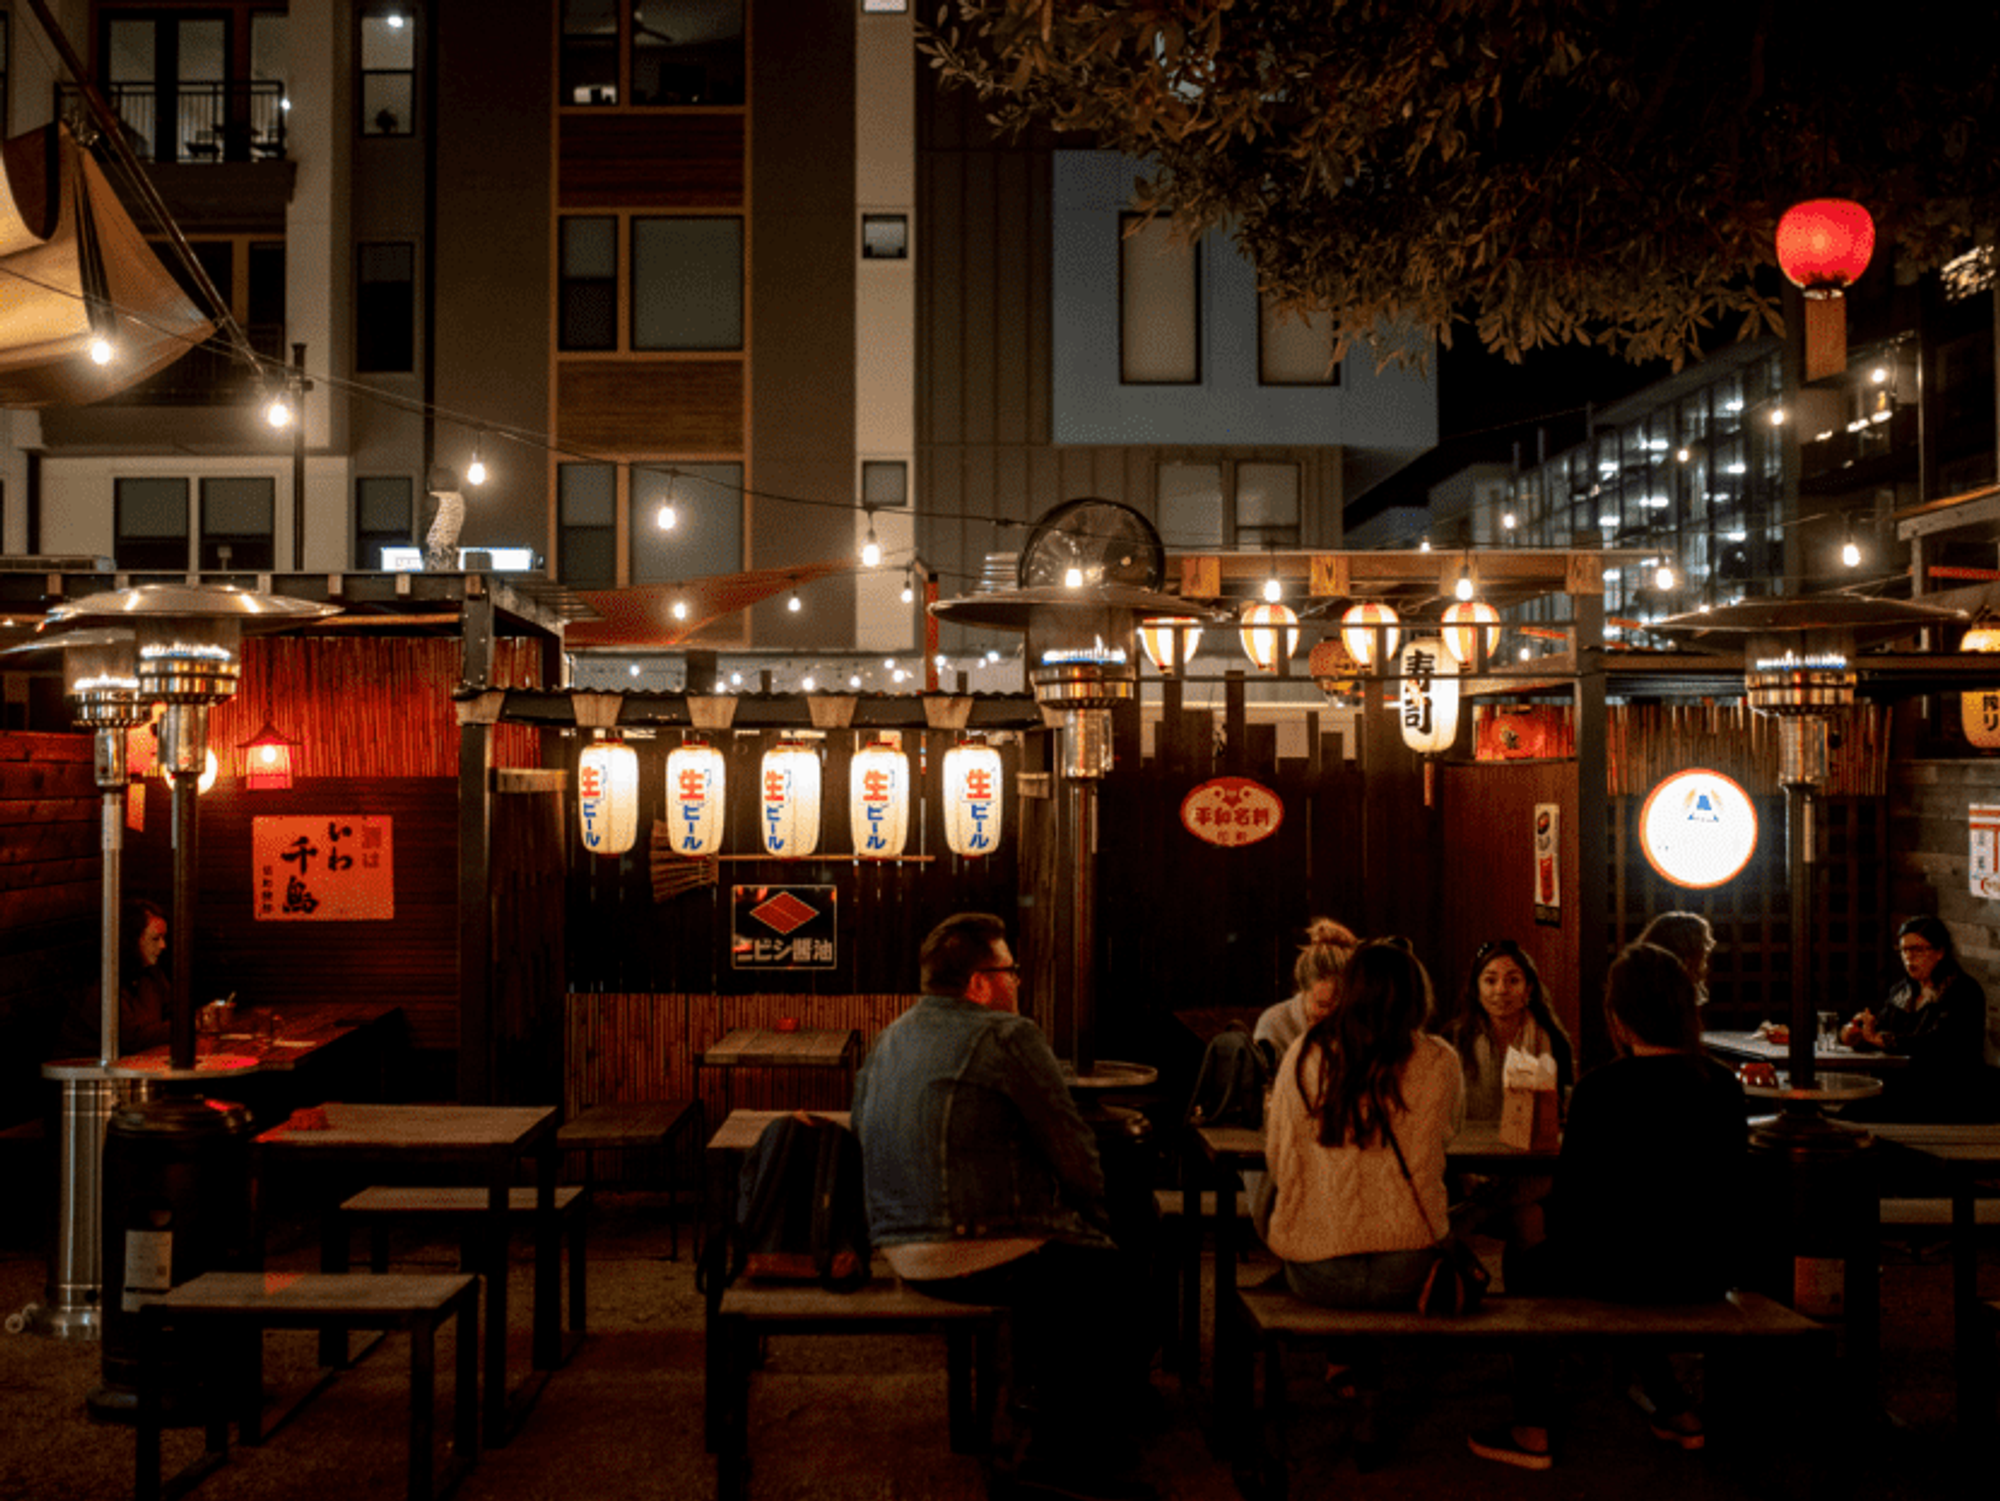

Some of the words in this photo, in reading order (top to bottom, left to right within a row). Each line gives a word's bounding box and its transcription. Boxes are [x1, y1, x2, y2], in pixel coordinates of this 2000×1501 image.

[581, 765, 602, 847] 生ビール
[679, 768, 705, 850] 生ビール
[763, 769, 785, 850] 生ビール
[863, 769, 889, 850] 生ビール
[966, 768, 991, 849] 生ビール
